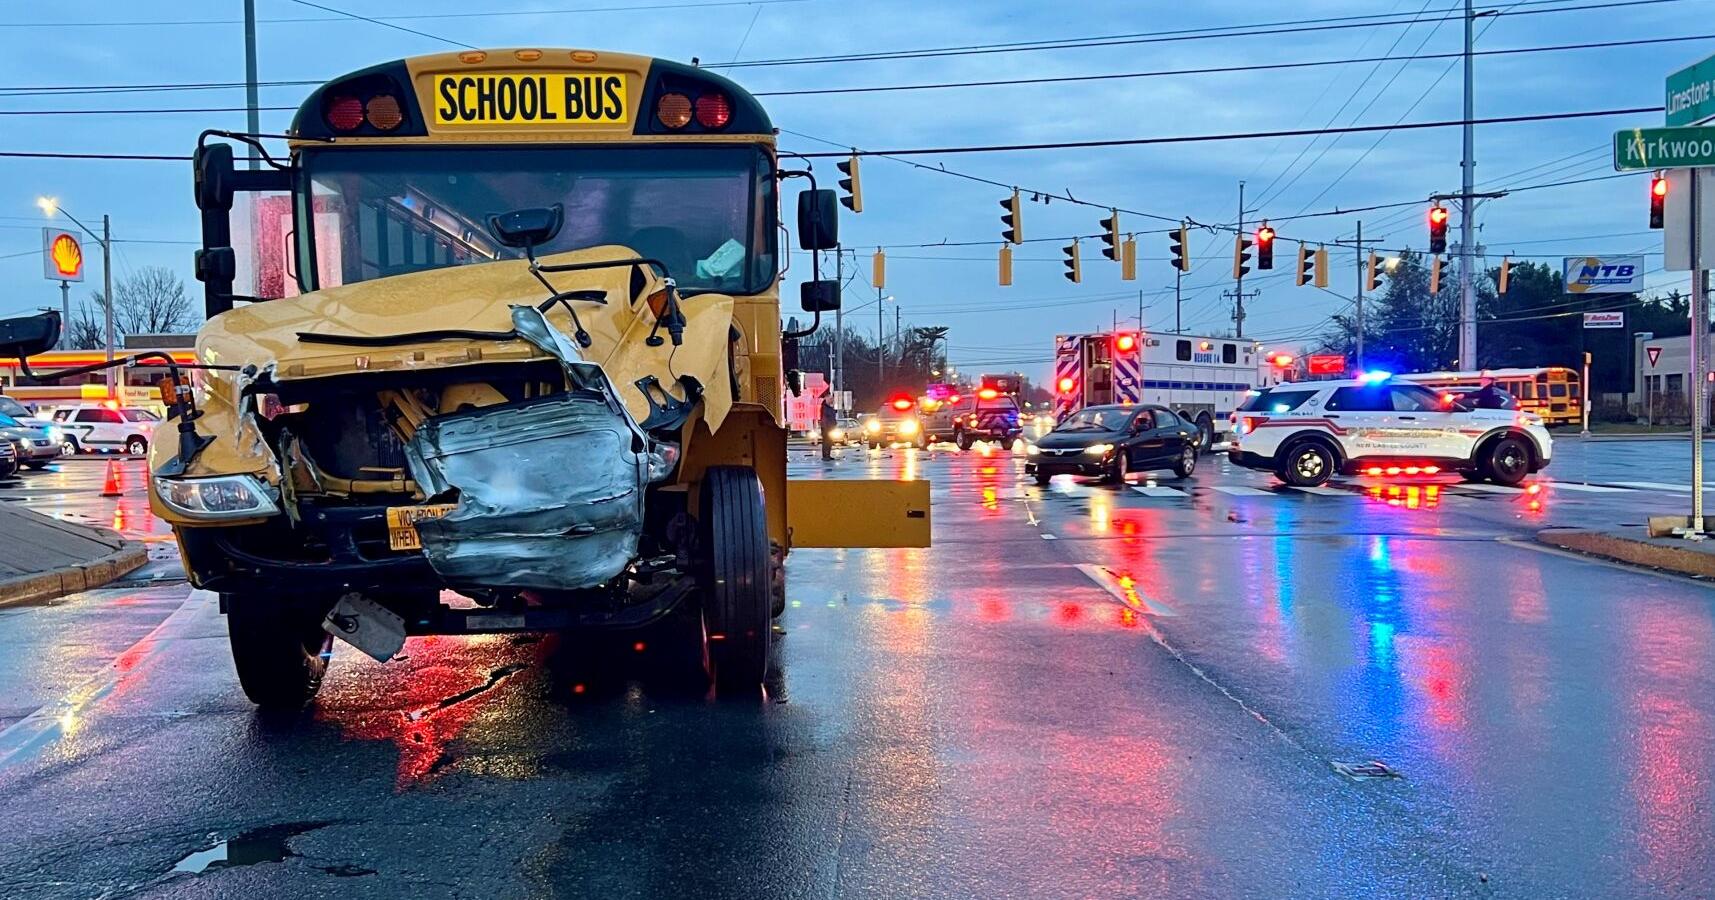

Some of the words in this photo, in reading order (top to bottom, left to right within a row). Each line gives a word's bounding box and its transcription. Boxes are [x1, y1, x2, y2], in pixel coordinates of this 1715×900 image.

[439, 76, 557, 121] SCHOOL
[564, 76, 623, 120] BUS
[1667, 81, 1710, 115] Limestone
[1626, 137, 1715, 160] Kirkwoo
[1579, 265, 1635, 277] NTB
[391, 530, 416, 547] WHEN
